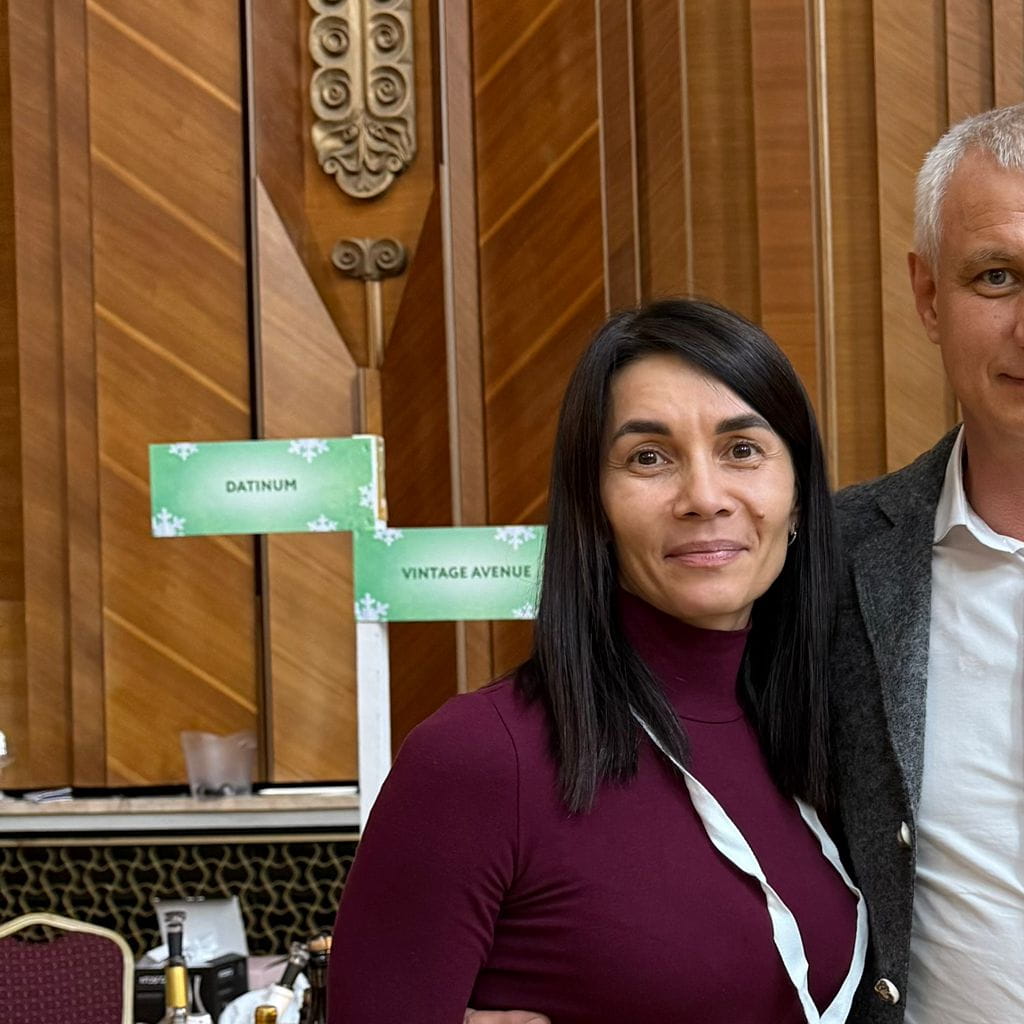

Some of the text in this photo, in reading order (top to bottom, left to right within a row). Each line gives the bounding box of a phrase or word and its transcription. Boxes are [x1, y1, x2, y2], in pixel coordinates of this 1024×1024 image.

[225, 478, 298, 494] DATINUM
[401, 564, 533, 581] VINTAGE AVENUE
